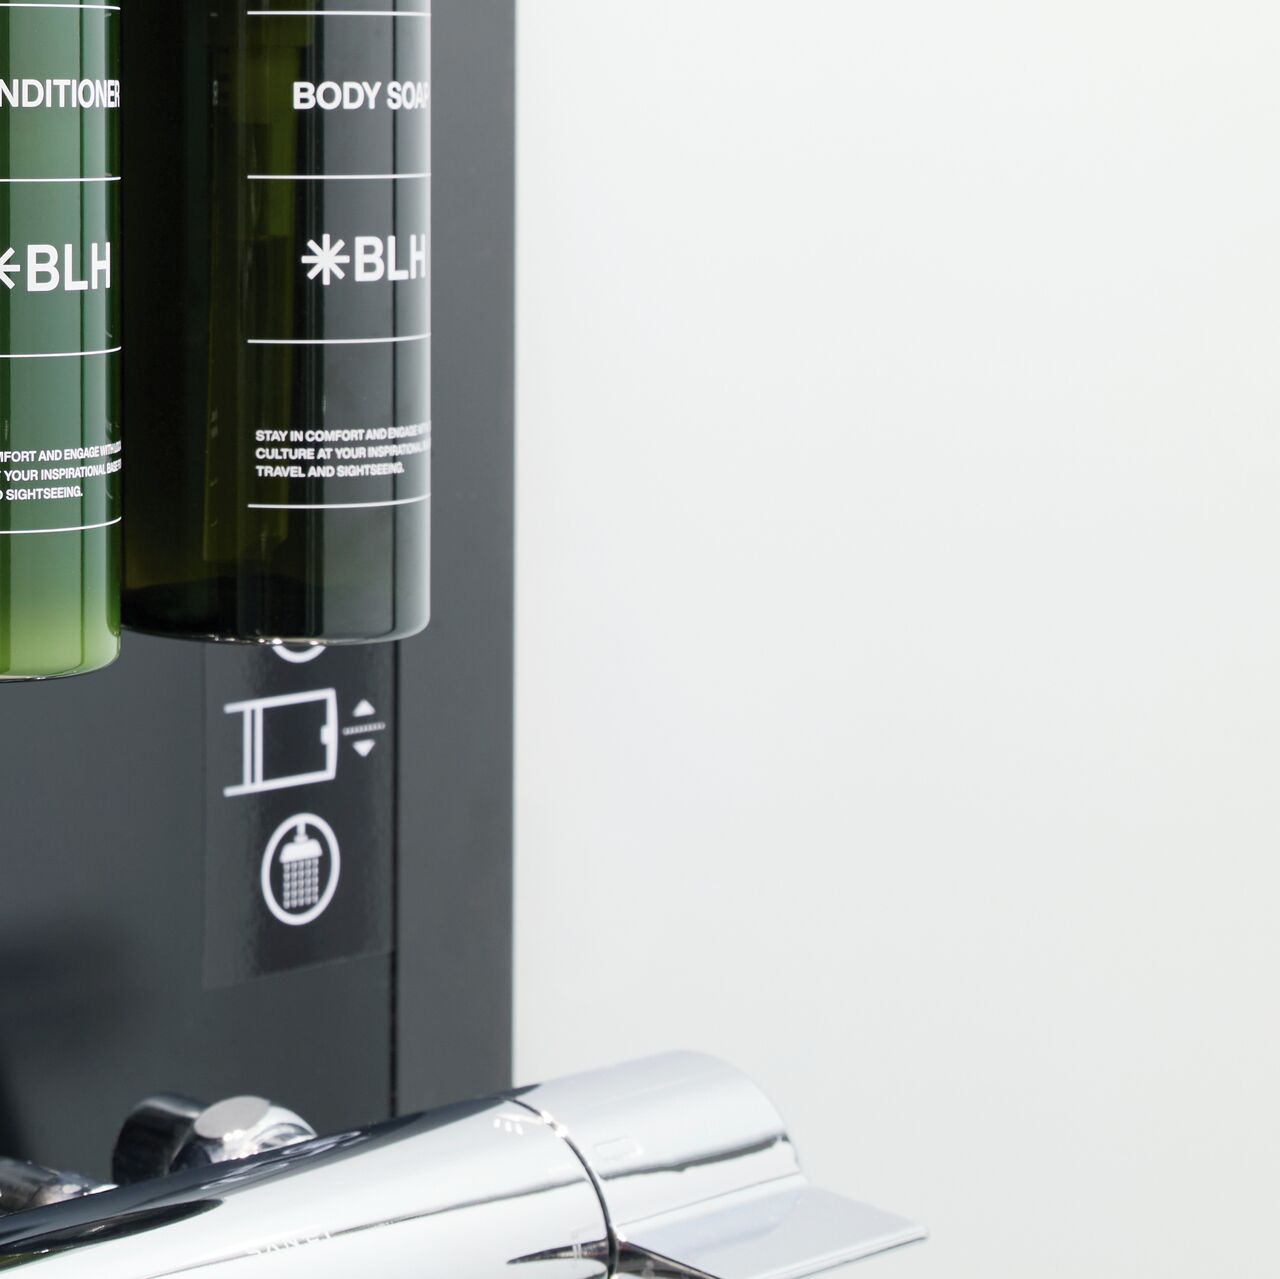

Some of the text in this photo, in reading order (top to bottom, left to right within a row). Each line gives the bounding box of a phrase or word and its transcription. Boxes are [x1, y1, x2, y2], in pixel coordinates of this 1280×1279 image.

[293, 81, 382, 110] BODY
[354, 233, 426, 282] BLH
[27, 242, 111, 292] BLH
[255, 430, 288, 442] STAY
[290, 430, 304, 442] IN
[305, 429, 365, 442] COMFORT
[365, 428, 387, 441] AND
[38, 449, 63, 462] AND
[64, 446, 100, 460] ENGAGE
[255, 448, 315, 460] CULTURE
[317, 448, 333, 460] AT
[334, 447, 367, 460] YOUR
[3, 469, 39, 482] YOUR
[40, 463, 106, 481] INSPIRATIONAL
[255, 466, 306, 478] TRAVEL
[307, 465, 336, 478] AND
[6, 485, 83, 501] SIGHTSEEING.
